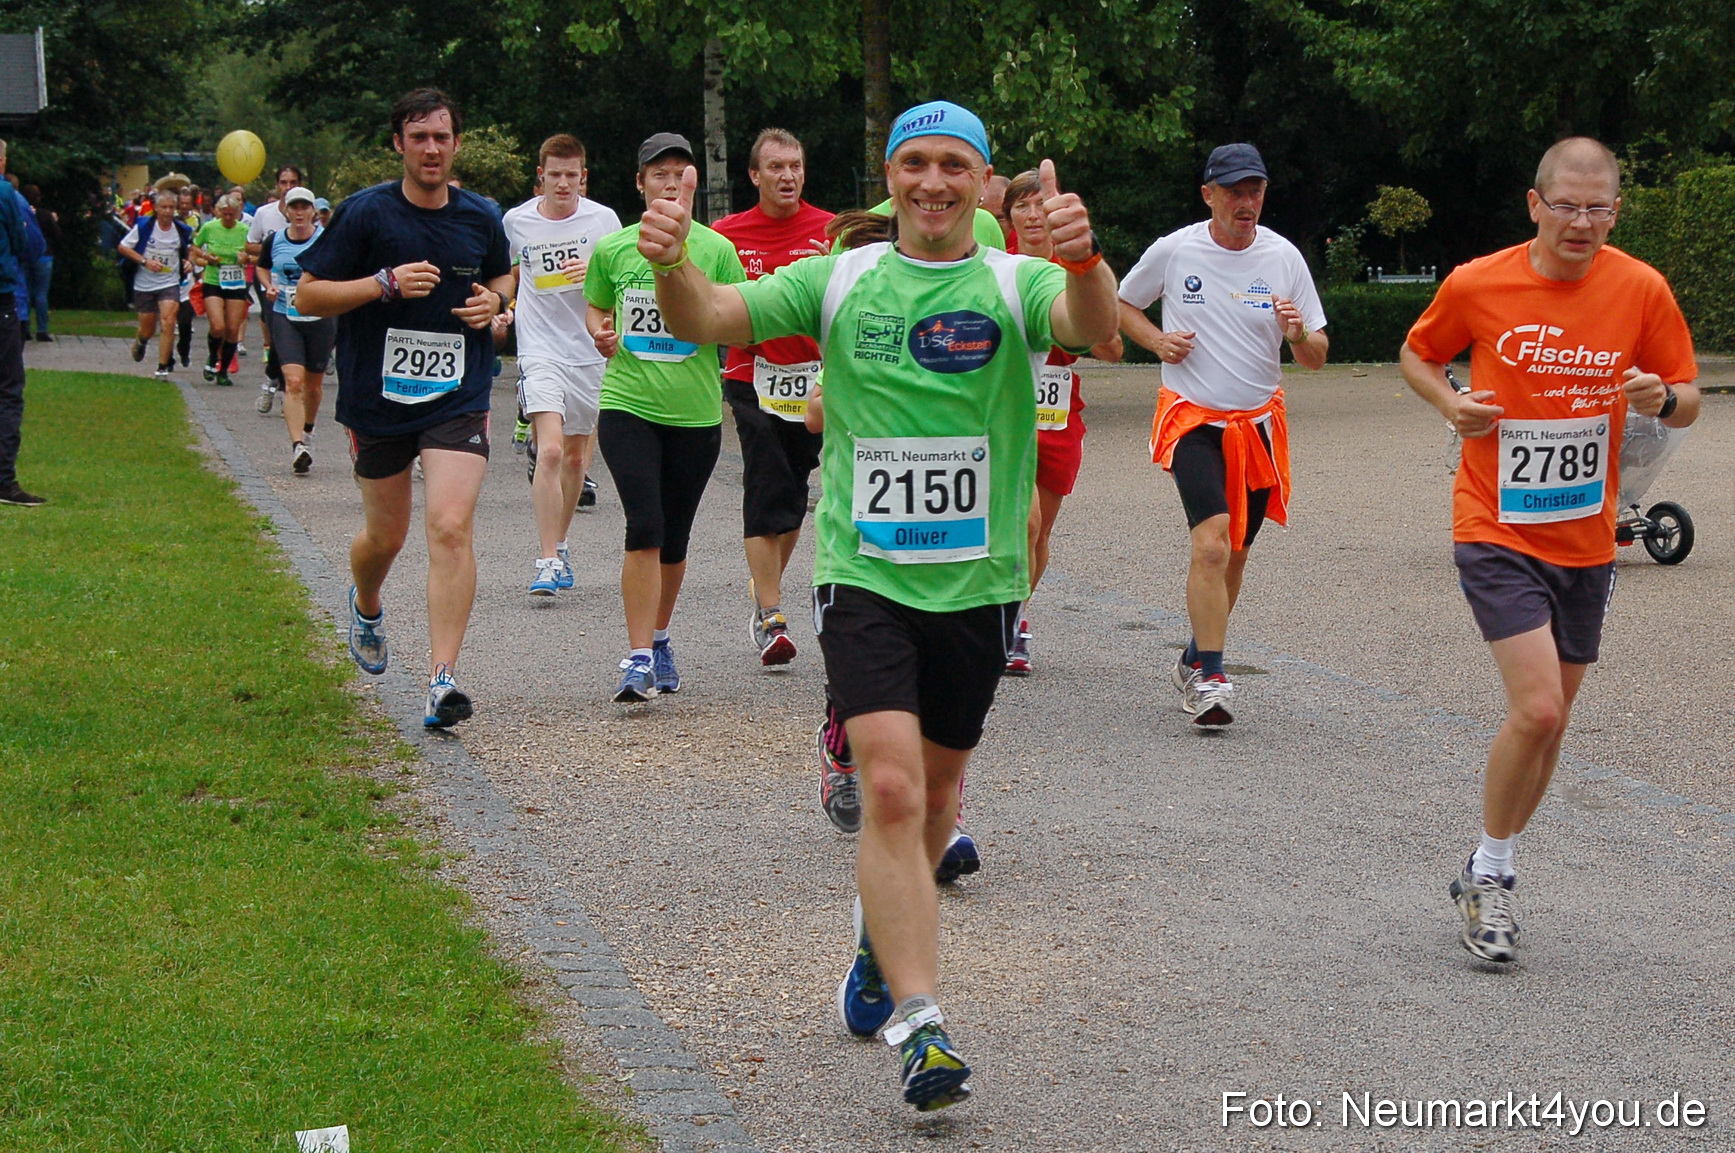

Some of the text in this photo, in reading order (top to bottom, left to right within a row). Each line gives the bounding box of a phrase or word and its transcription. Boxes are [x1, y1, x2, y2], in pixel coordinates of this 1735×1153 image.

[529, 239, 579, 252] PARTL Neumarkt
[542, 247, 580, 272] 535
[625, 296, 650, 305] PARTL
[631, 307, 671, 334] 23
[387, 335, 451, 348] PARTL Neumarkt
[648, 340, 674, 351] Anita
[854, 351, 900, 364] RICHTER
[1517, 340, 1622, 366] Fischer
[391, 347, 456, 378] 2923
[756, 361, 777, 372] PARTL
[1527, 364, 1614, 377] AUTOMOBILE
[767, 375, 807, 397] 159
[1568, 384, 1589, 396] das
[1036, 382, 1059, 406] 58
[1037, 412, 1056, 422] raud
[1501, 428, 1593, 440] PARTL Neumarkt
[856, 450, 966, 462] PARTL Neumarkt
[1510, 442, 1599, 483] 2789
[868, 468, 977, 515] 2150
[1523, 491, 1587, 509] Christian
[895, 527, 948, 546] Oliver
